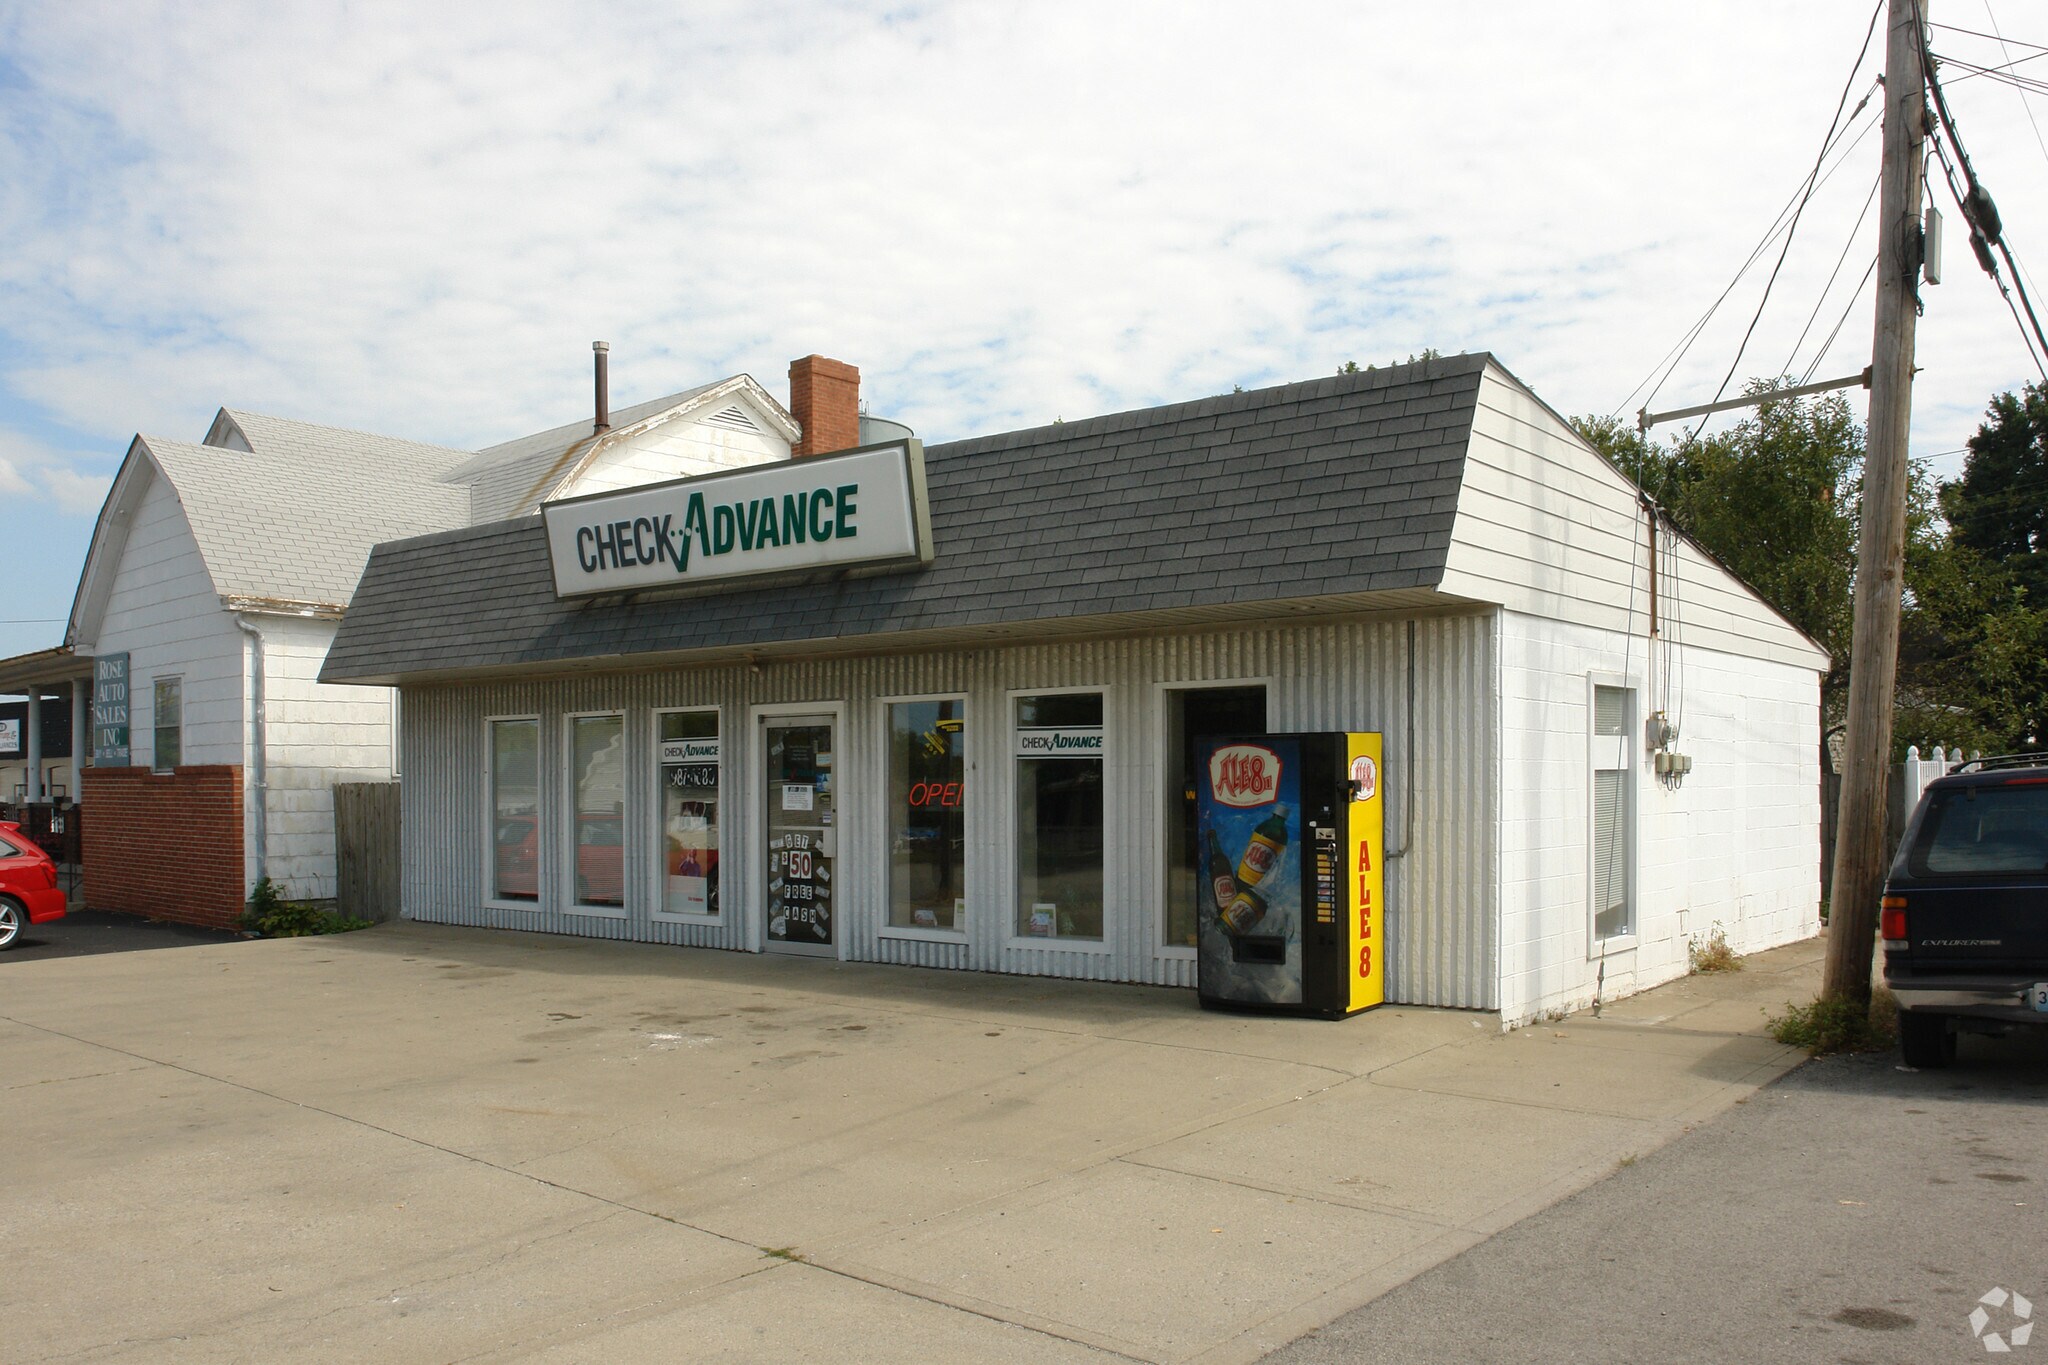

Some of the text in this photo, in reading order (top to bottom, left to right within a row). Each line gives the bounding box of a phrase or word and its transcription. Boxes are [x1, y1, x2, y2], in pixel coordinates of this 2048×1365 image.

[576, 484, 859, 573] CHECK ADVANCE
[99, 661, 124, 681] ROSE
[98, 683, 125, 703] AUTO
[96, 705, 127, 725] SALES
[103, 728, 120, 747] INC
[1022, 733, 1103, 751] CHECK ADVANCE
[785, 834, 808, 848] GET
[785, 886, 812, 899] FREE
[783, 907, 816, 922] CASH
